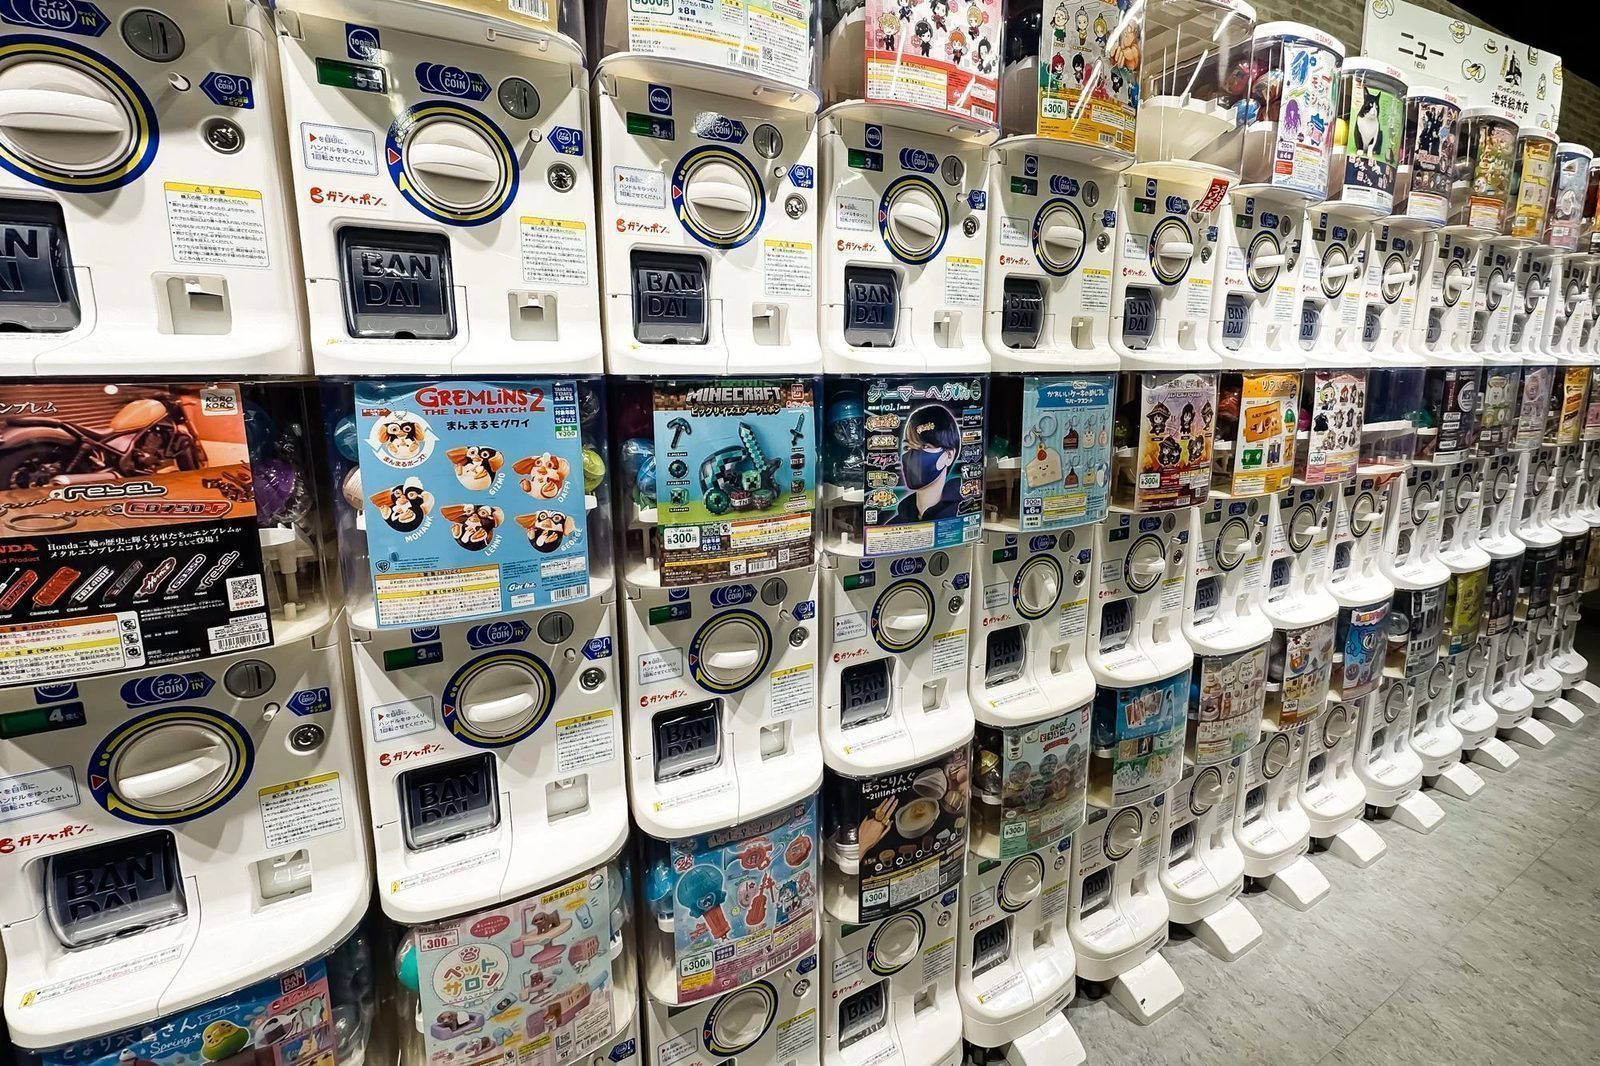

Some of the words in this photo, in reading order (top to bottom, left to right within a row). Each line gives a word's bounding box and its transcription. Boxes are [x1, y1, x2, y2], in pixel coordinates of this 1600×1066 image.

[38, 8, 71, 23] COIN
[81, 16, 97, 28] IN
[1398, 32, 1444, 60] ニュー
[1414, 61, 1426, 70] NEW
[444, 71, 465, 80] コイン
[444, 78, 467, 90] COIN
[472, 83, 483, 93] IN
[1491, 92, 1529, 114] 池袋総本店
[715, 125, 731, 135] COIN
[310, 144, 365, 156] ハンドルをゆっくり
[913, 158, 927, 166] COIN
[326, 190, 382, 207] ガシャポン
[627, 222, 666, 234] ガシャポン
[845, 240, 875, 252] ガシャポン
[361, 251, 433, 281] BAN
[645, 271, 697, 294] BAN
[363, 279, 421, 308] DAI
[854, 284, 893, 304] BAN
[648, 295, 688, 318] DAI
[1010, 294, 1040, 311] BAN
[1129, 301, 1151, 316] BAN
[855, 305, 885, 325] DAI
[1009, 312, 1033, 328] DAI
[1128, 316, 1148, 331] DAI
[1226, 320, 1243, 334] DAI
[206, 395, 233, 403] KORO
[529, 388, 545, 412] 2
[686, 386, 781, 402] MINECRAFT
[205, 401, 235, 409] KORO
[422, 408, 451, 416] THE
[487, 406, 527, 414] BATCH
[446, 418, 530, 431] まんまるモグワイ
[489, 472, 506, 496] GIZMO
[558, 480, 572, 503] DAFFY
[405, 515, 433, 543] MOHAWK
[484, 534, 503, 556] LENNY
[10, 556, 41, 564] Product
[74, 566, 111, 602] CBX400F
[728, 592, 742, 600] COIN
[491, 629, 510, 640] COIN
[514, 627, 524, 636] IN
[157, 677, 181, 686] コイン
[157, 683, 184, 695] COIN
[191, 681, 204, 690] IN
[850, 674, 885, 695] BAN
[650, 690, 685, 704] ガシャポン
[666, 721, 711, 744] BAN
[392, 744, 440, 762] ガシャポン
[419, 772, 480, 809] BAN
[862, 772, 916, 794] ほっこりんぐ
[18, 824, 87, 847] ガシャポン
[67, 853, 156, 900] BAN
[69, 888, 142, 924] DAI
[979, 929, 1006, 951] BAN
[443, 957, 499, 980] ペット
[283, 971, 304, 985] BAN
[285, 979, 304, 991] DAI
[443, 971, 503, 996] サロン
[847, 991, 881, 1020] BAN
[150, 1035, 193, 1057] Spring
